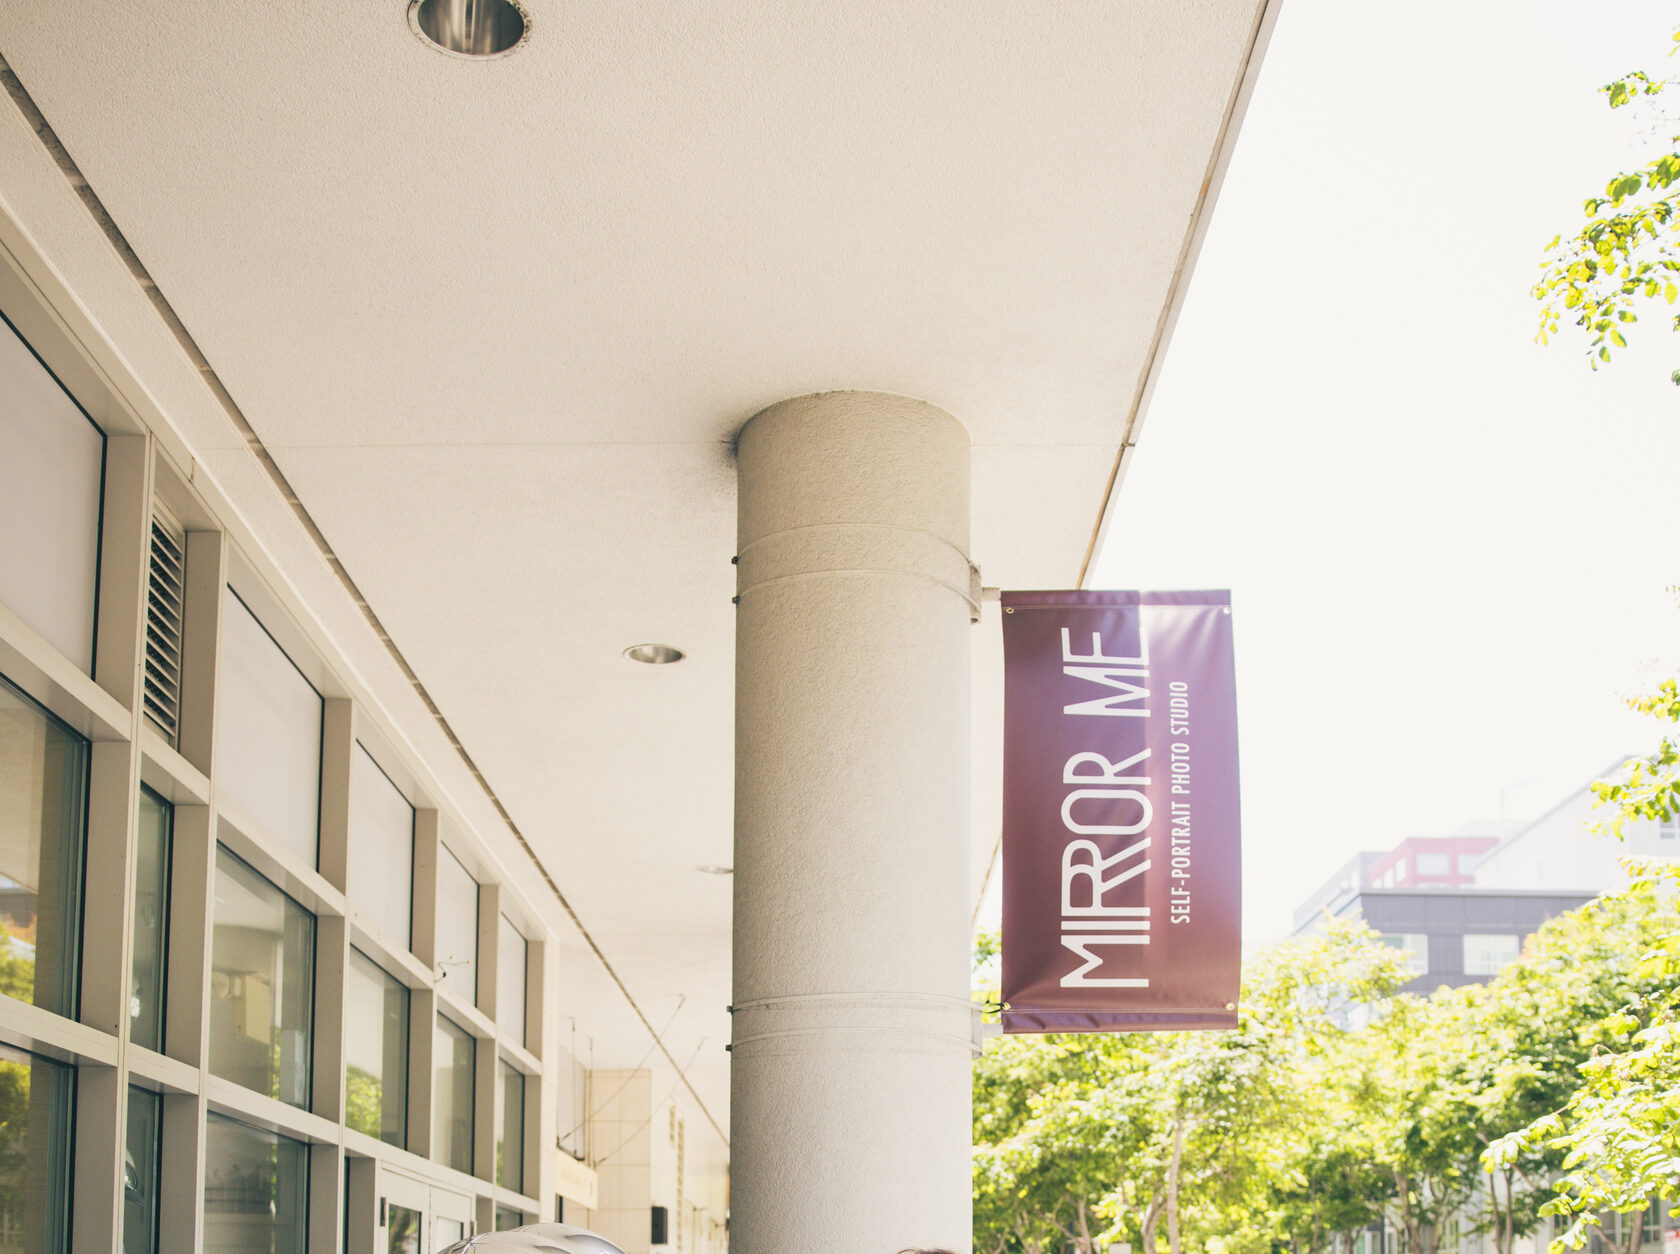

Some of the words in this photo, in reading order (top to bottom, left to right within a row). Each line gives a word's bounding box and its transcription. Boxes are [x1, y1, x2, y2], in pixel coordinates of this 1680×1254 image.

[1060, 626, 1151, 718] ME
[1169, 681, 1189, 736] STUDIO
[1170, 742, 1190, 796] PHOTO
[1060, 746, 1154, 988] MIRROR
[1170, 800, 1190, 924] SELF-PORTRAIT
